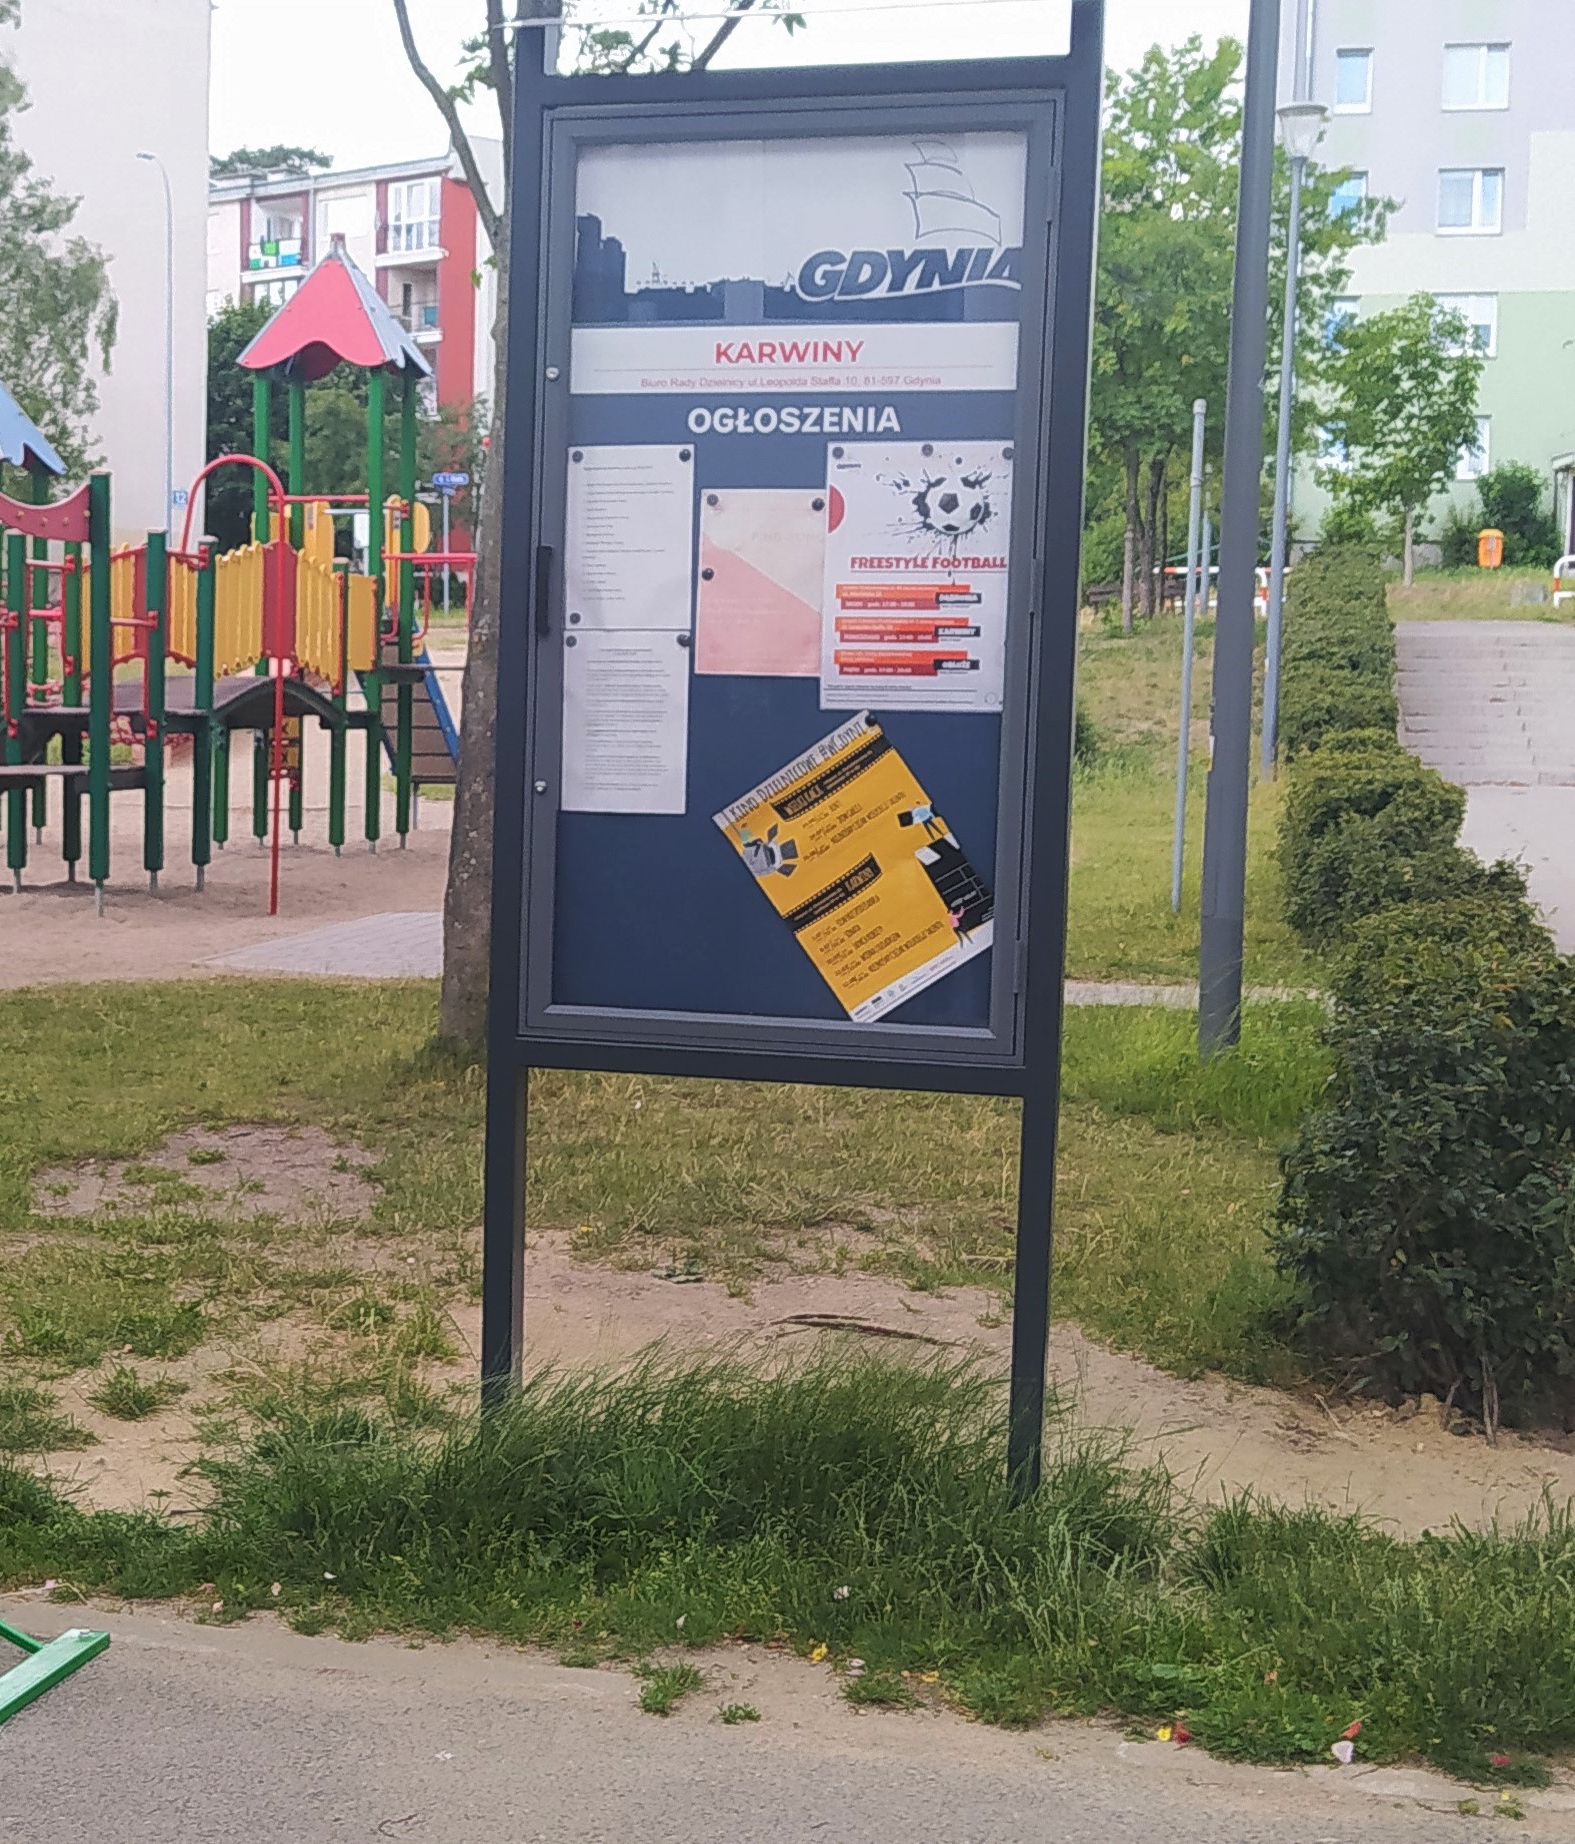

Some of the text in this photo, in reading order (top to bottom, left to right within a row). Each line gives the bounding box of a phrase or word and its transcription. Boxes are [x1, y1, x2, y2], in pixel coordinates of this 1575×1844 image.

[796, 248, 1022, 300] GDYNIA
[715, 340, 864, 364] KARWINY
[640, 378, 667, 388] Biuro
[670, 377, 695, 389] Rady
[699, 376, 744, 389] Dzielnicy
[810, 375, 842, 387] Staffa
[903, 374, 942, 387] Gdynia
[687, 405, 901, 434] OGŁOSZENIA
[850, 556, 1008, 570] FREESTYLE FOOTBALL
[728, 794, 760, 822] KINO
[756, 753, 822, 803] DZIELNICOWE
